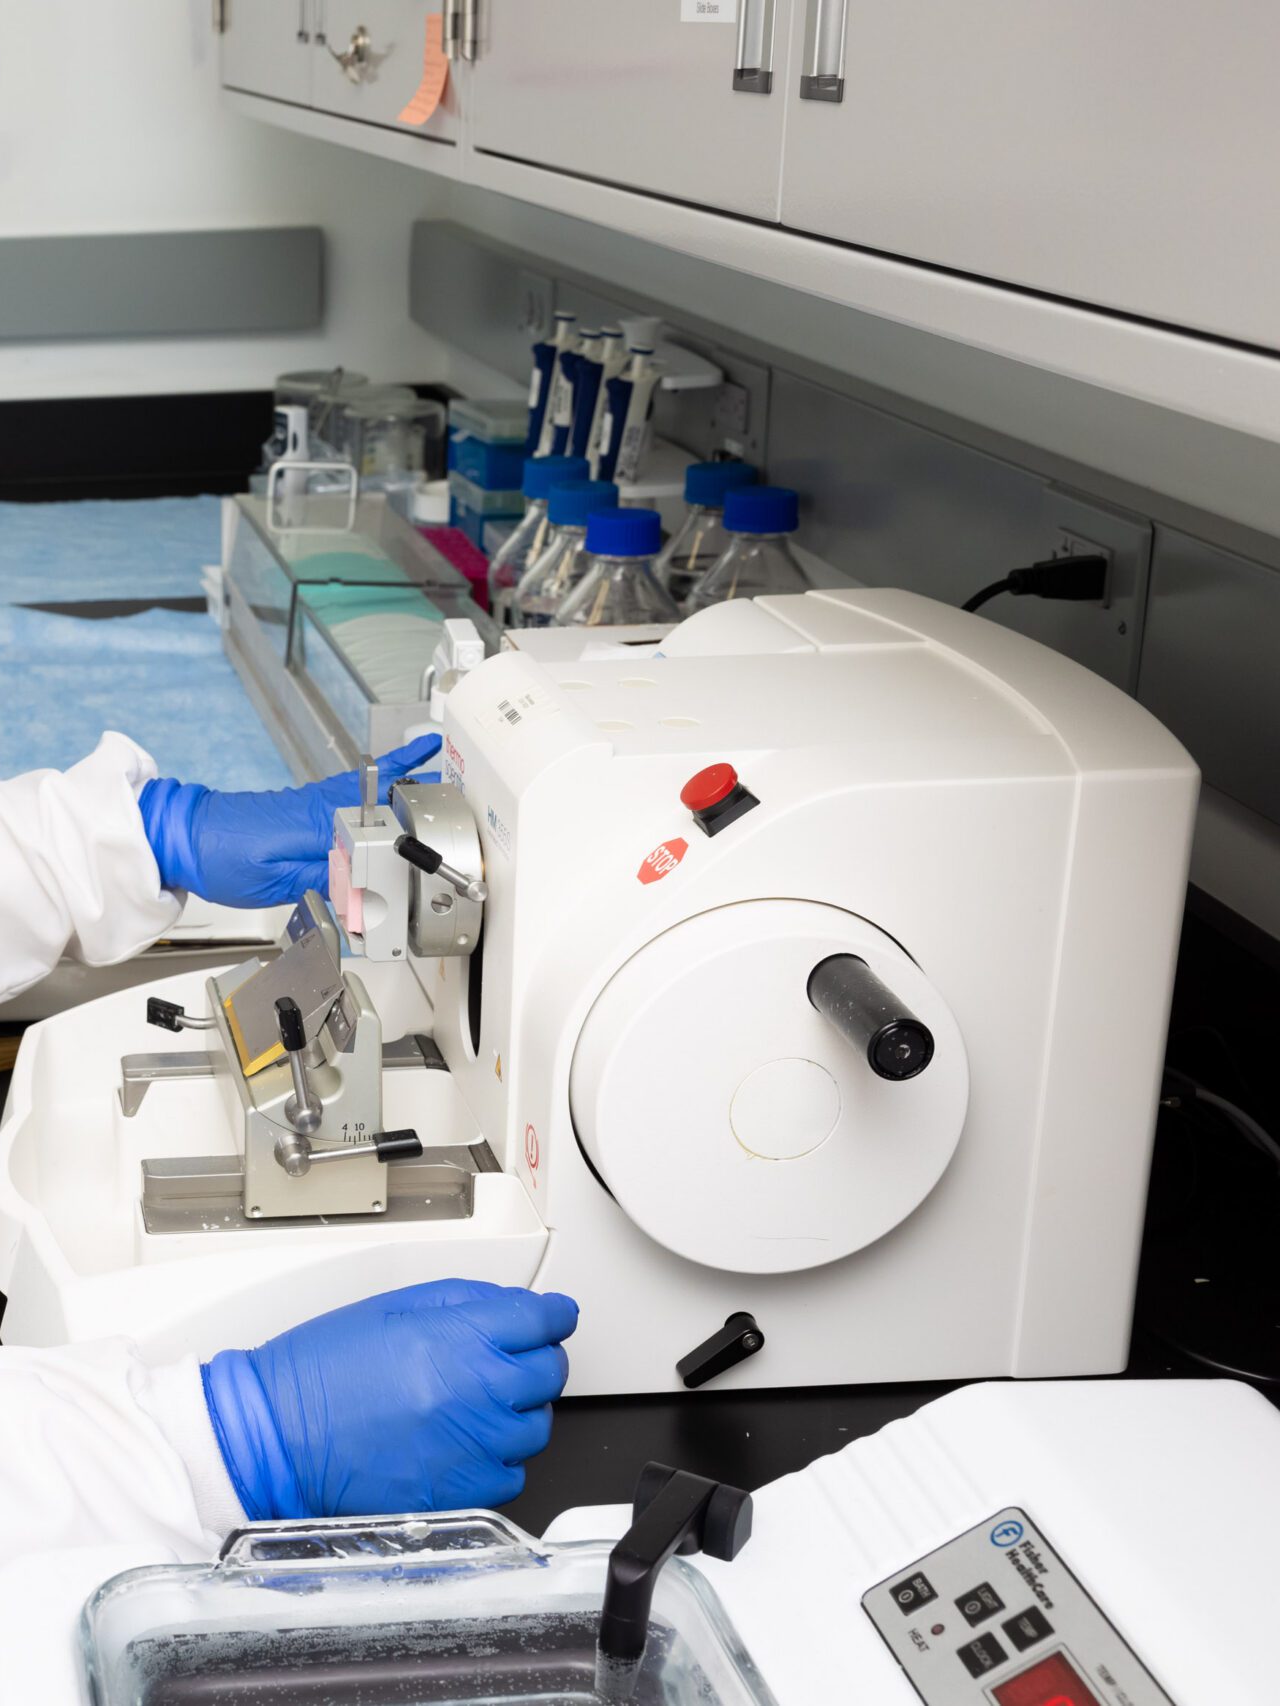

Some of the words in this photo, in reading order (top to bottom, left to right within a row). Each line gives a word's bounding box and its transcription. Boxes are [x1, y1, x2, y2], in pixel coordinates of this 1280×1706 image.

[647, 845, 678, 874] STOP
[354, 1122, 365, 1131] 10
[1019, 1540, 1049, 1574] Fisher
[912, 1577, 932, 1599] BATH
[1005, 1548, 1054, 1610] HealthCare
[908, 1628, 930, 1652] HEAT
